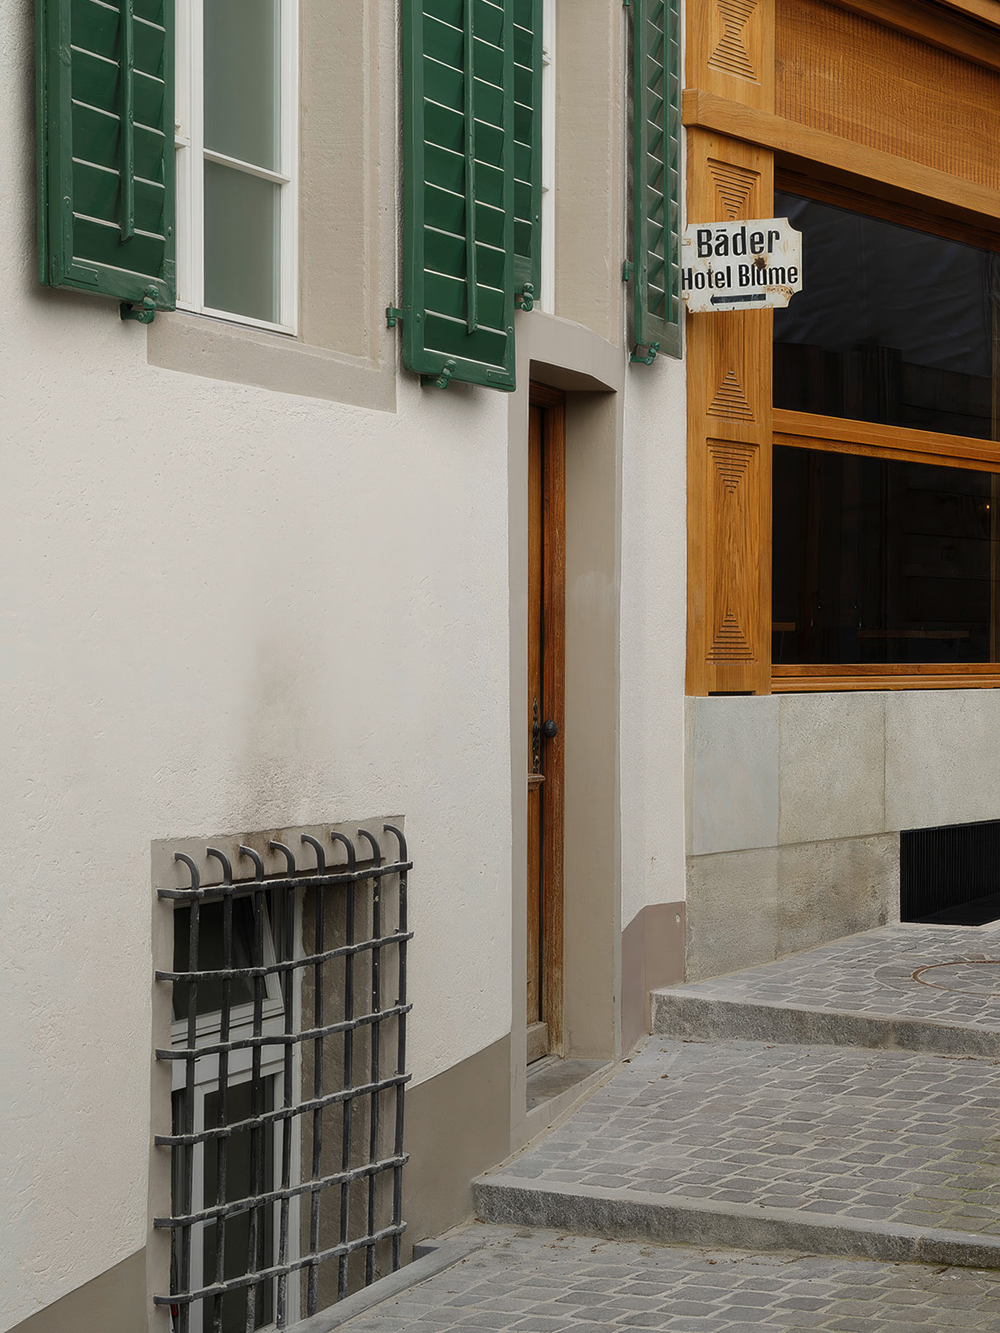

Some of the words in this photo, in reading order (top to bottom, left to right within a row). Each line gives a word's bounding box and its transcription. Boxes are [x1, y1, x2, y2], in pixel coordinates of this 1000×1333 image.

[696, 226, 780, 259] Bäder
[682, 265, 732, 290] Hotel
[738, 264, 798, 287] Blume
